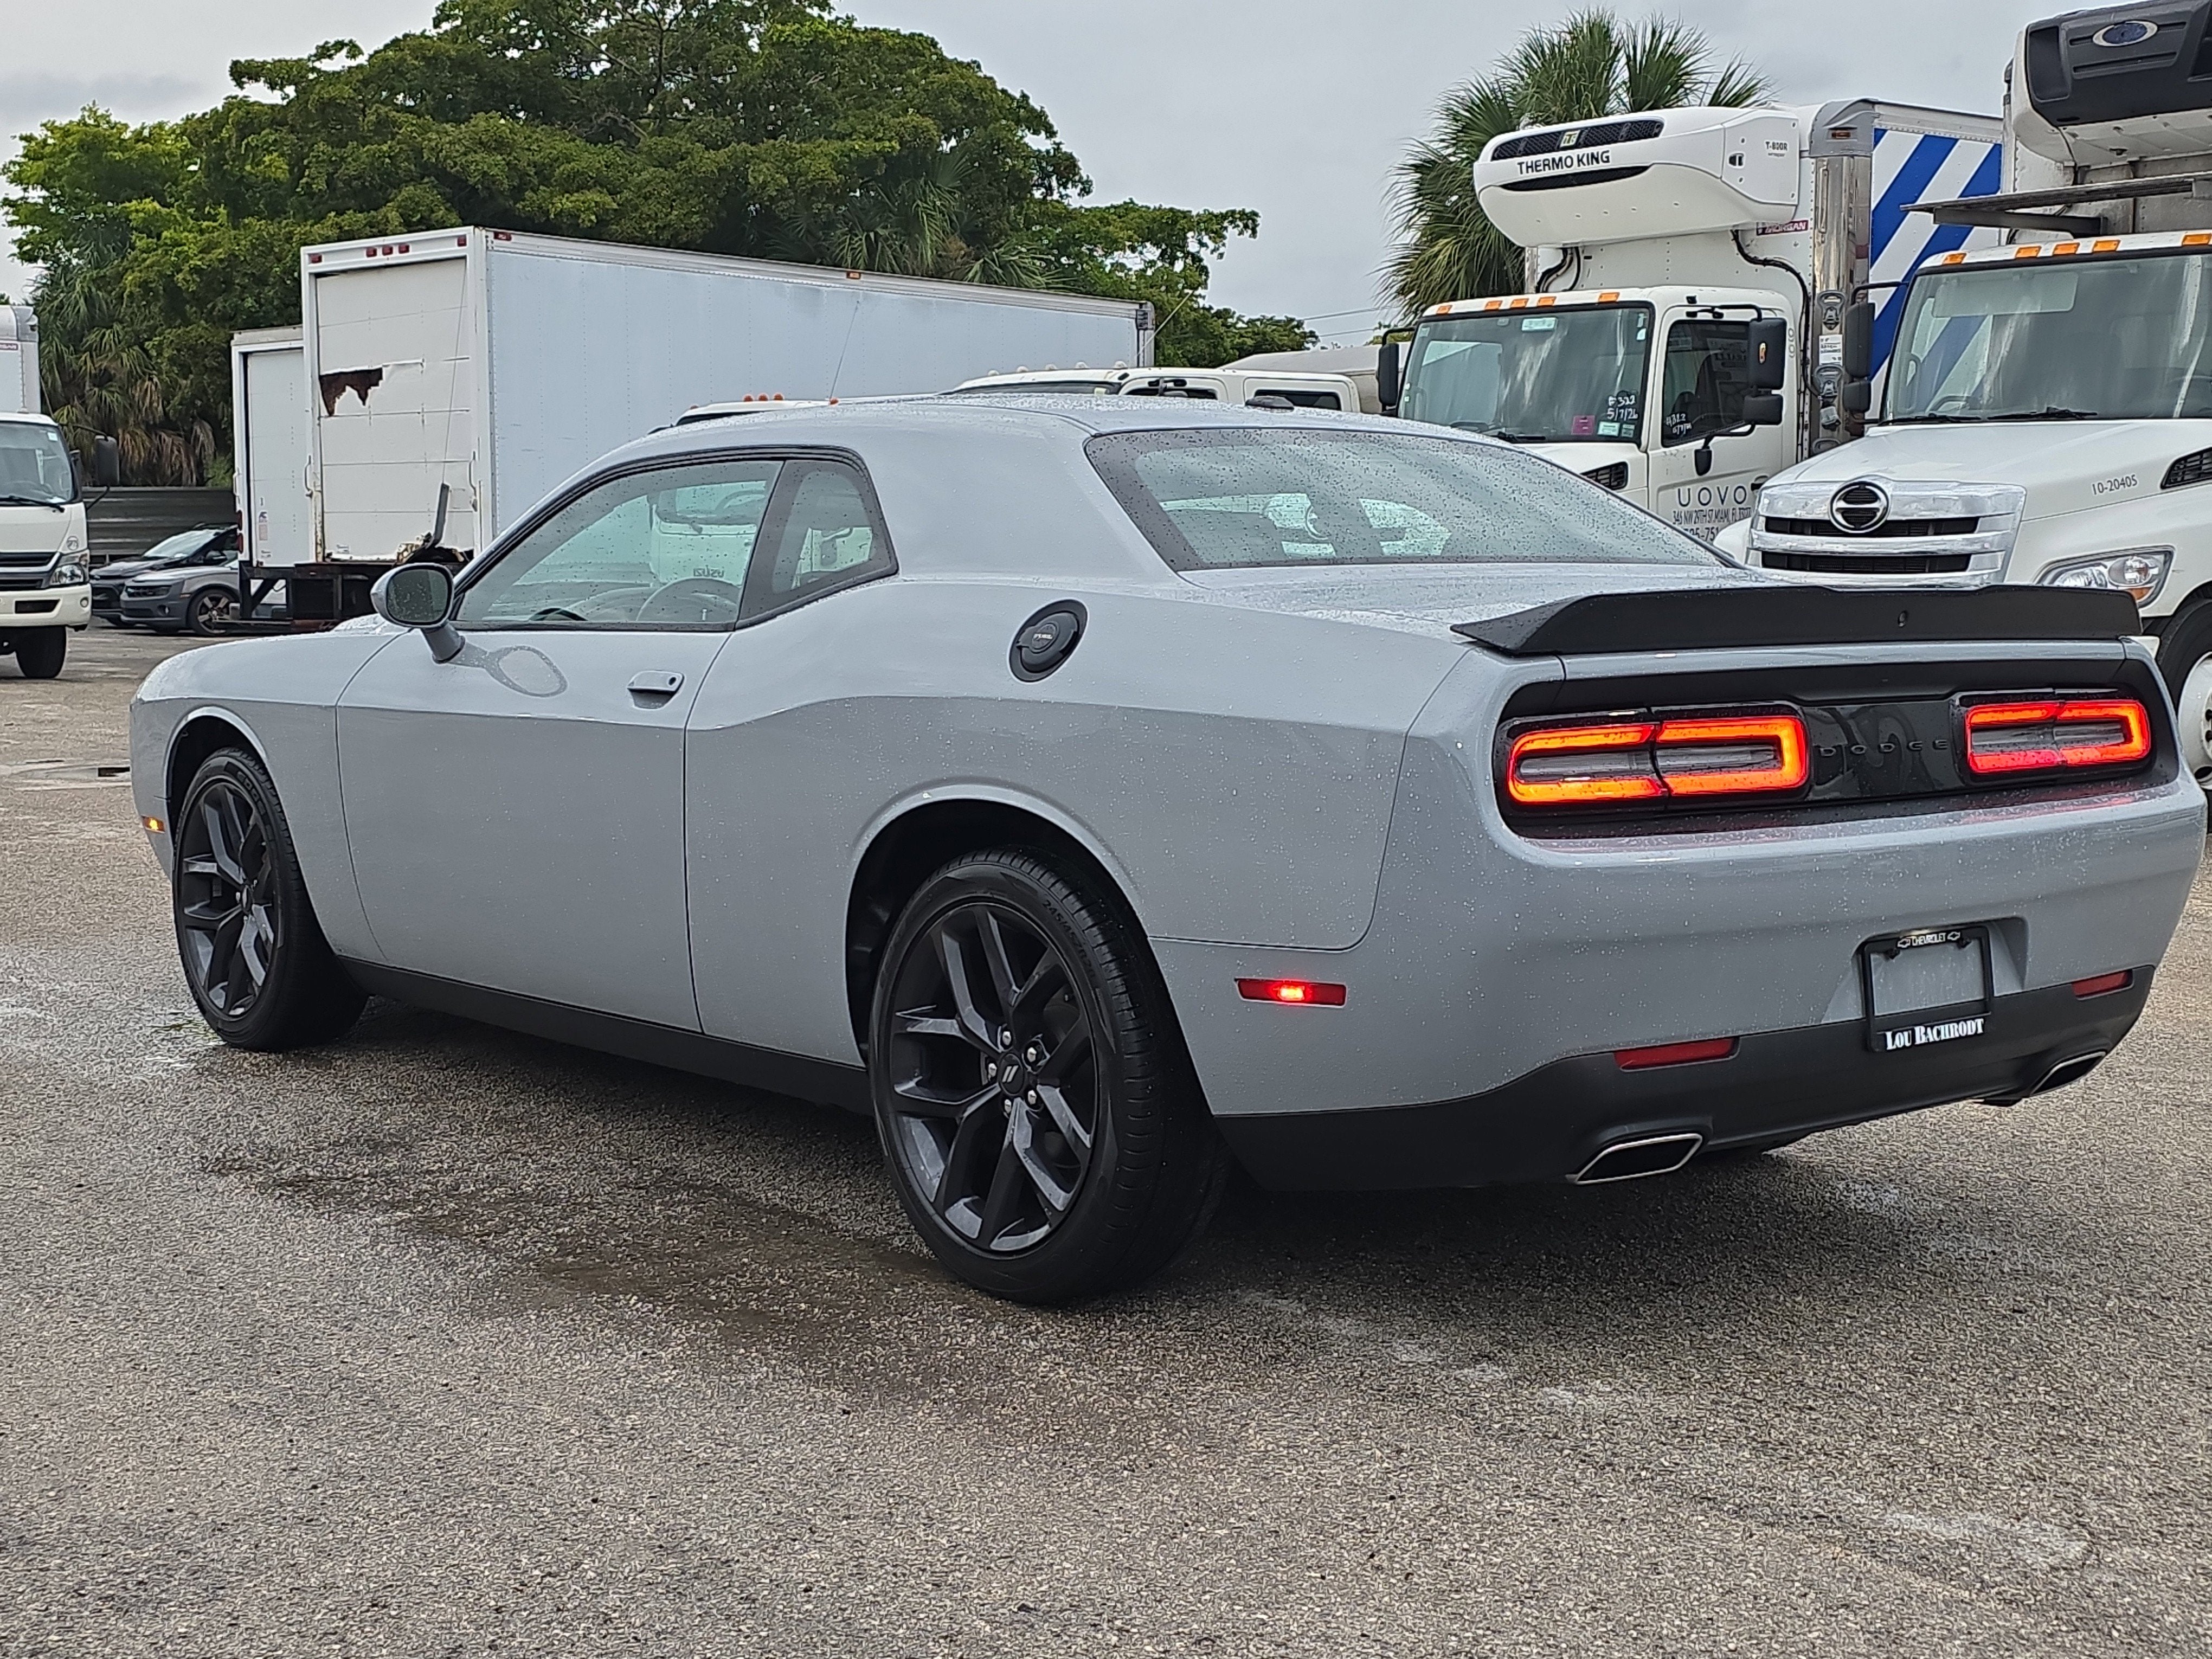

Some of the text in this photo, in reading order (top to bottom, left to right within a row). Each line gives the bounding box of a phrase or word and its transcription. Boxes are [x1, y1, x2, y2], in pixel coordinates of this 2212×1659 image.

[1517, 150, 1610, 175] THERMO KING
[2092, 474, 2138, 495] 10-20405
[1677, 485, 1747, 507] UOVO
[1820, 739, 1950, 757] DODGE
